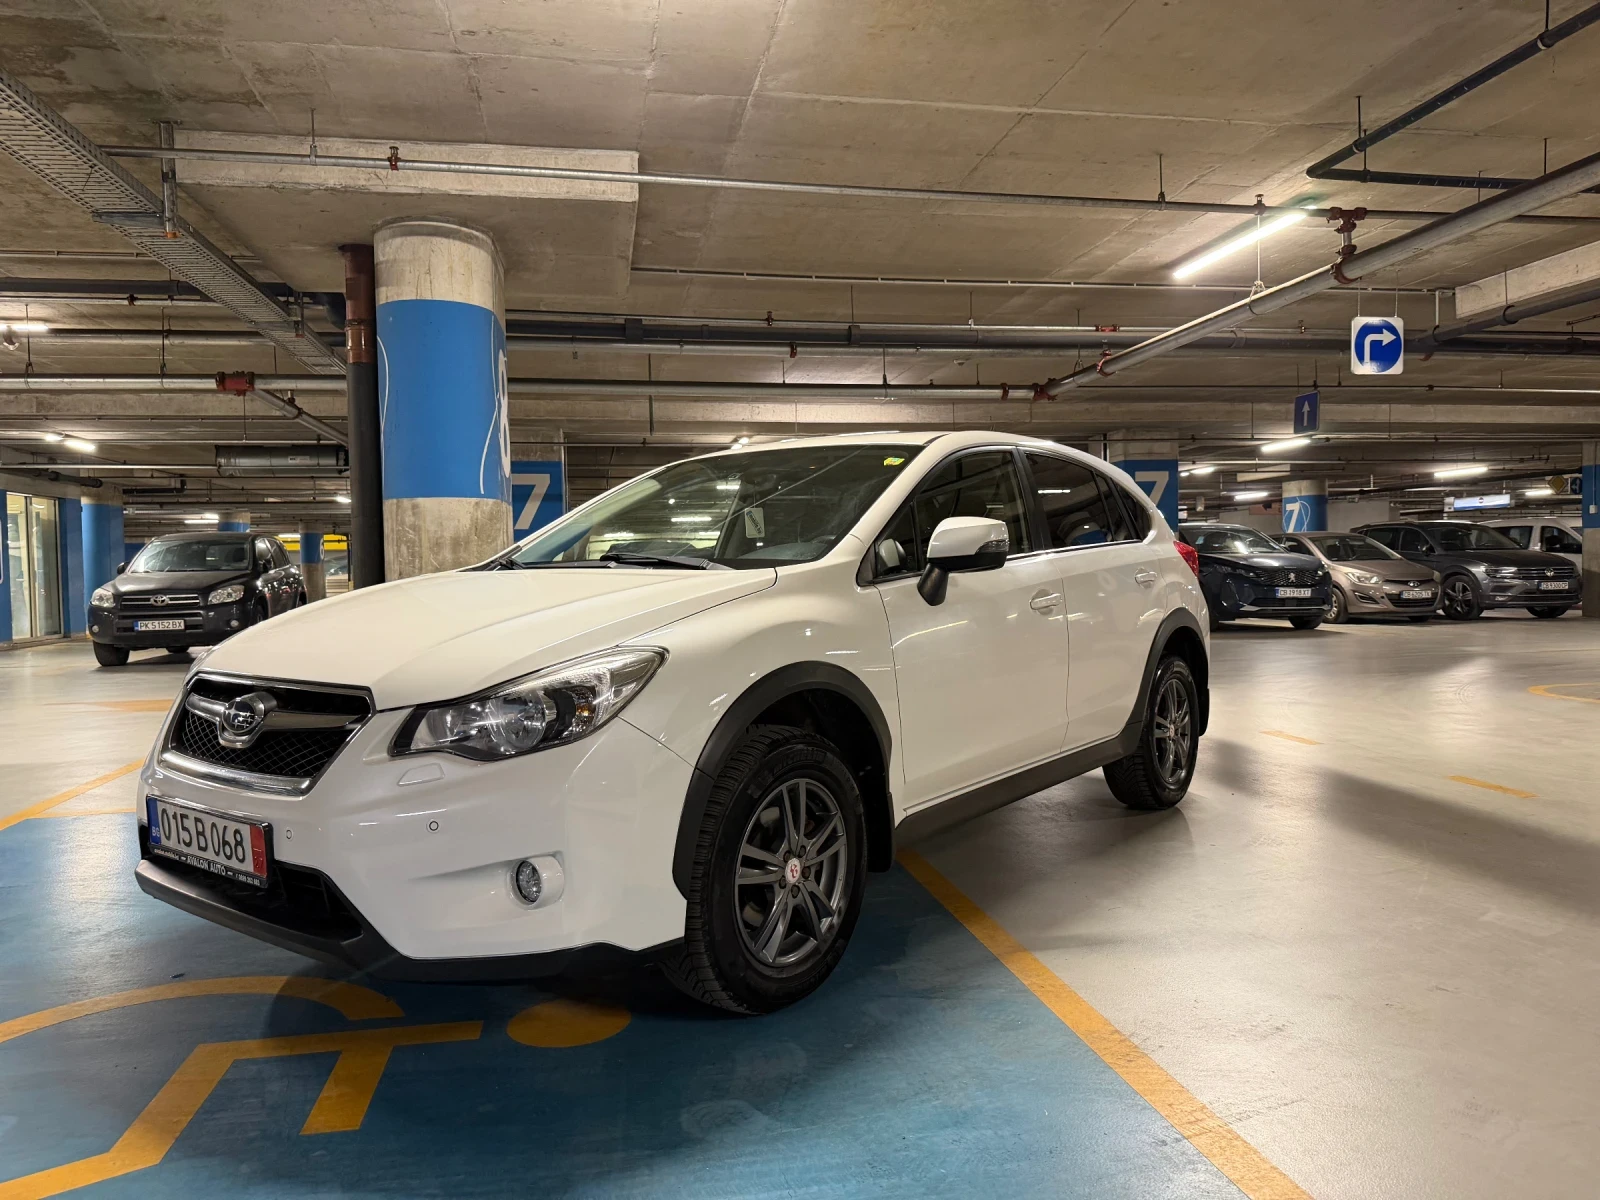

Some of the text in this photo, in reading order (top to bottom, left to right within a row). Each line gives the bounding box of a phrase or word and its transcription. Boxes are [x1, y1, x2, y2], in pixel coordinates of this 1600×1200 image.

[511, 473, 551, 530] 7
[1134, 471, 1169, 506] 7
[1285, 502, 1300, 533] 7
[151, 826, 161, 838] BG
[187, 855, 226, 876] AVALON AUTO
